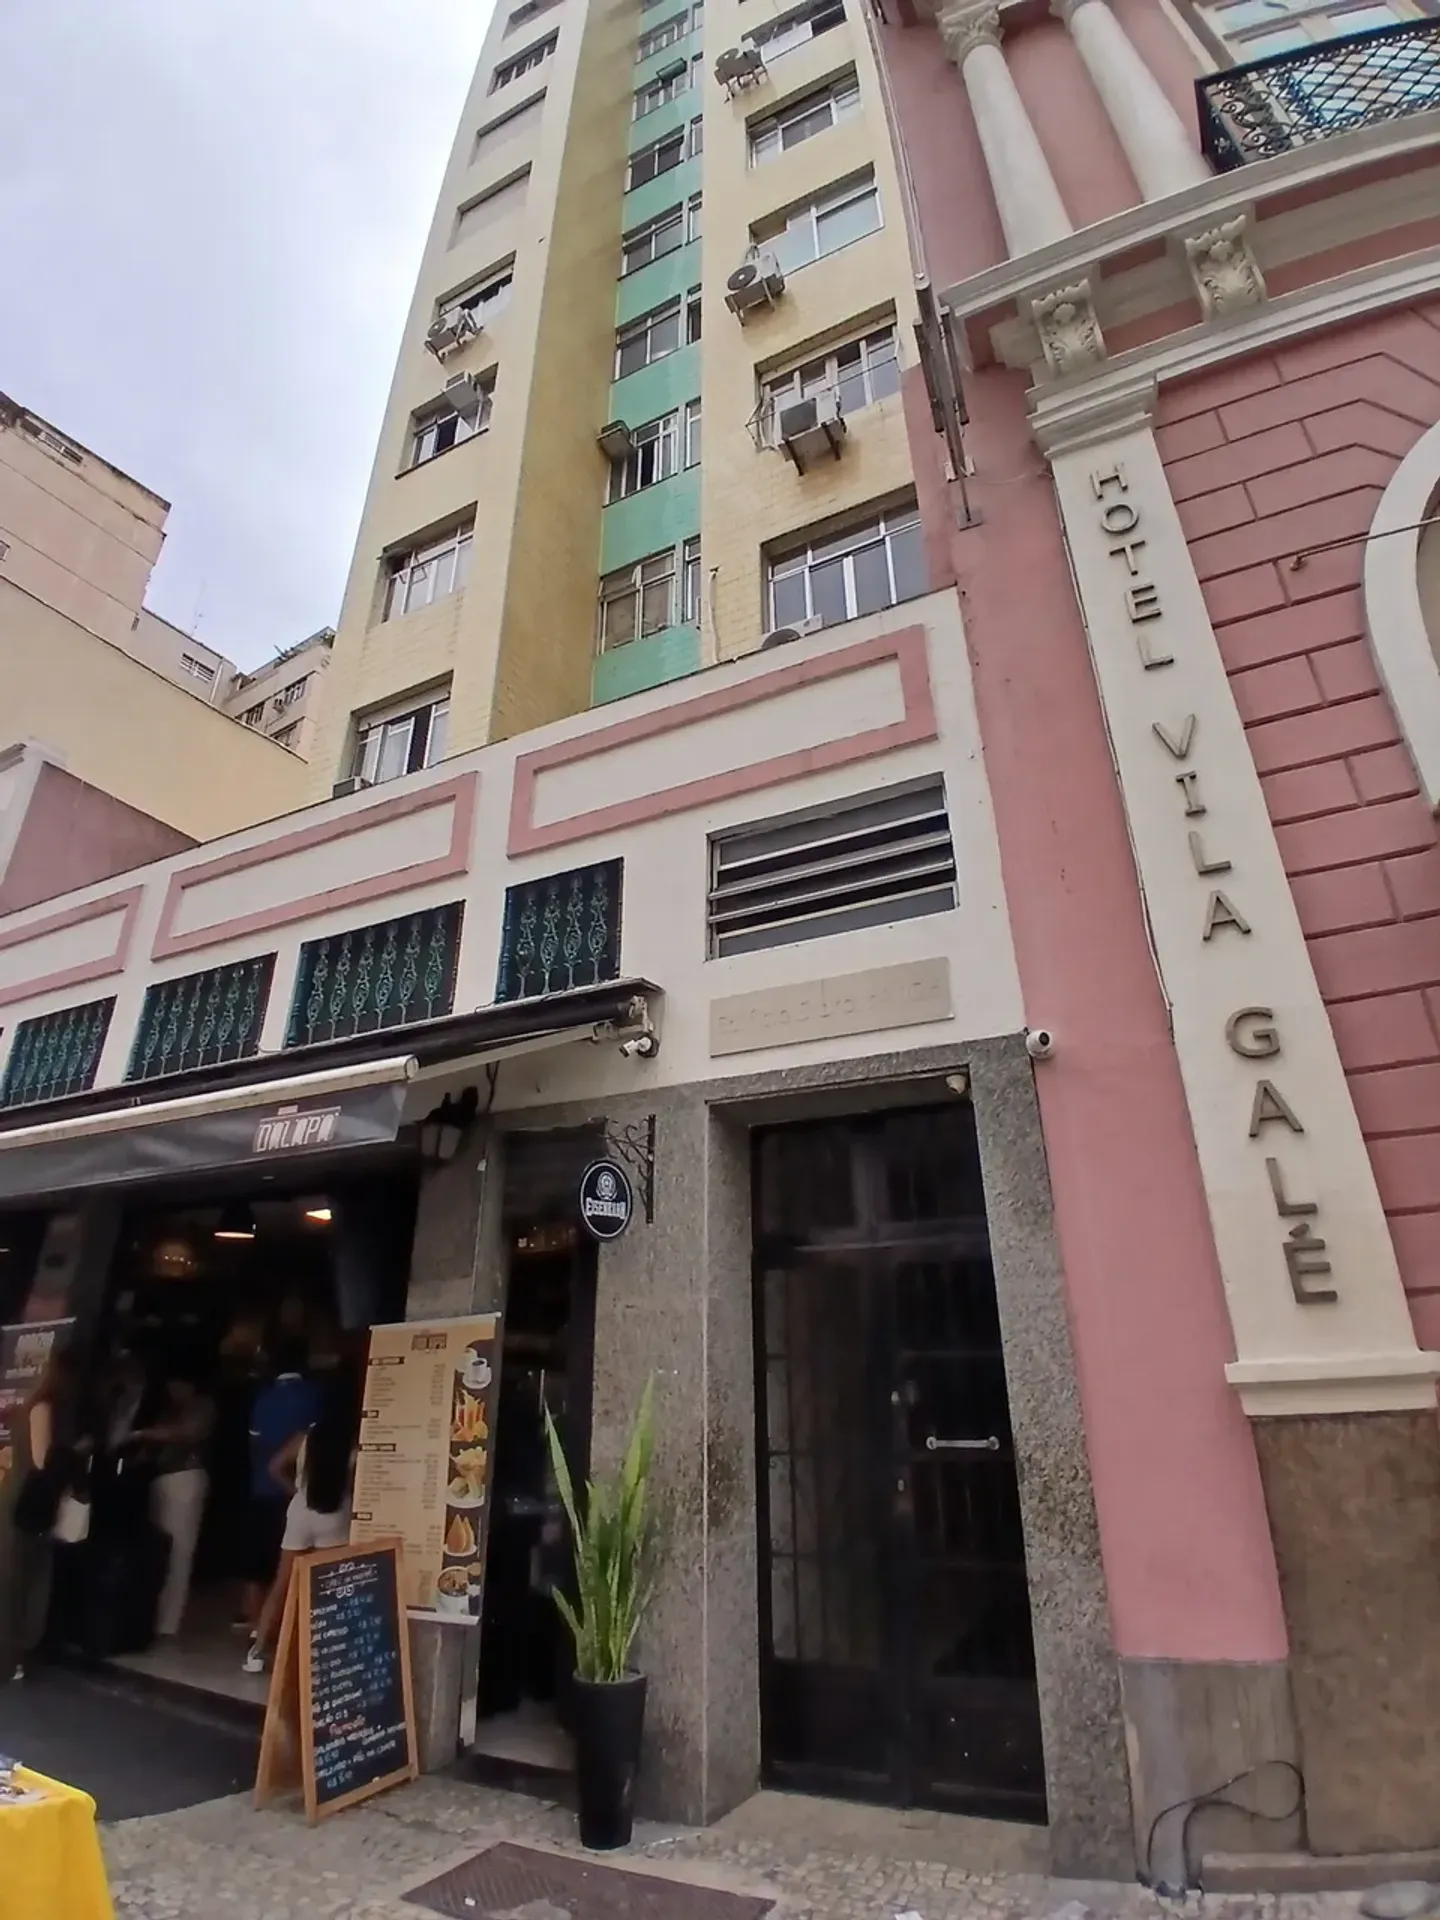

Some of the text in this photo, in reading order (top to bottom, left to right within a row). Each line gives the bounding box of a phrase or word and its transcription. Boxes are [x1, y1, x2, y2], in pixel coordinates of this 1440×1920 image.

[1090, 462, 1338, 1305] HOTEL VILA GALÉ
